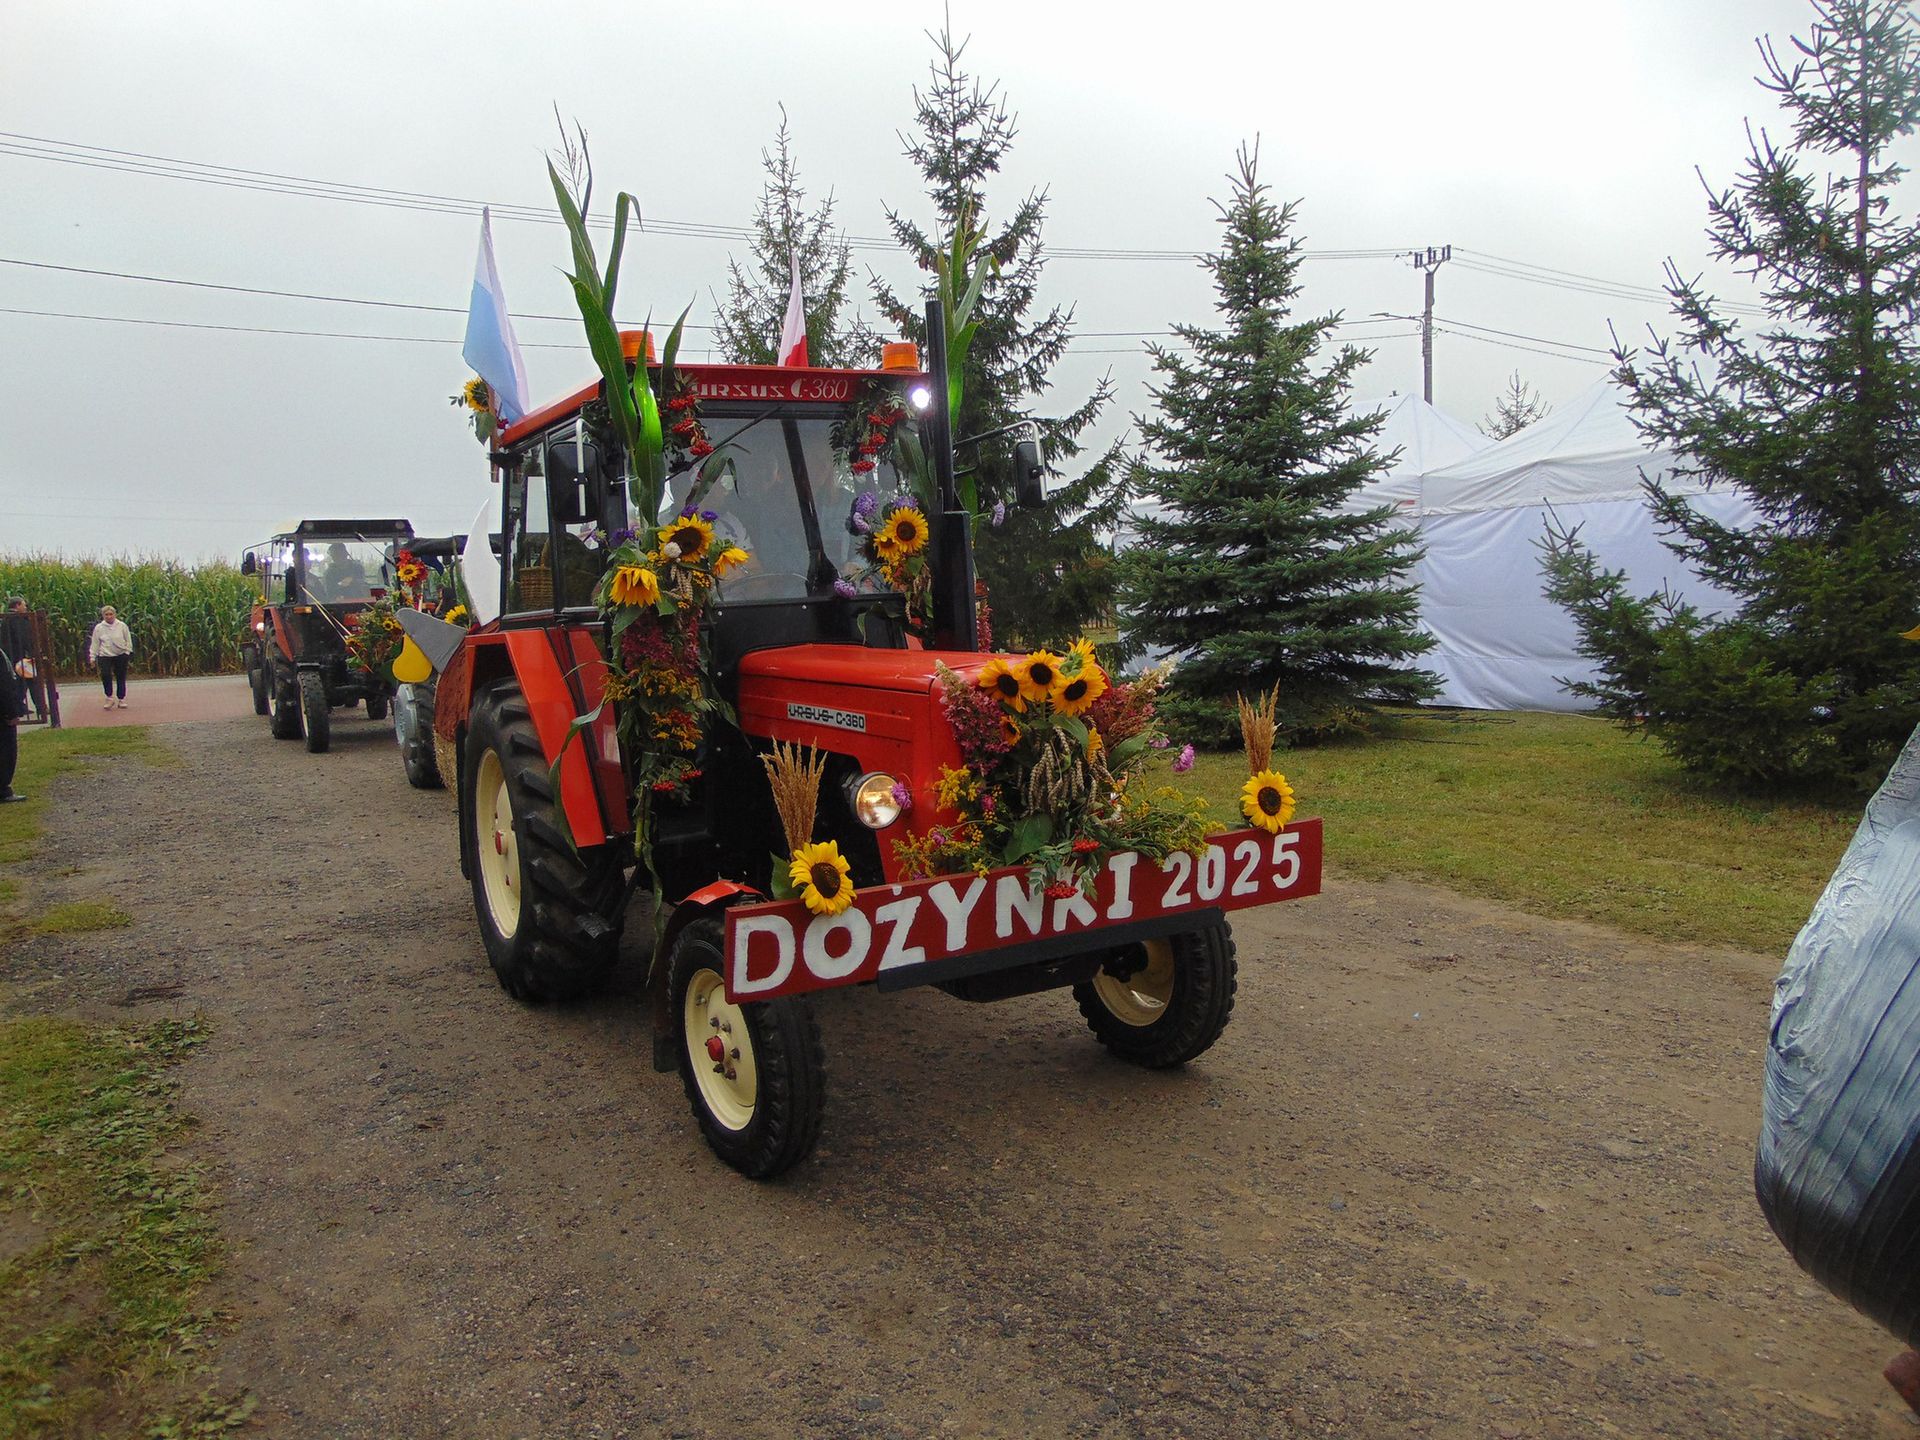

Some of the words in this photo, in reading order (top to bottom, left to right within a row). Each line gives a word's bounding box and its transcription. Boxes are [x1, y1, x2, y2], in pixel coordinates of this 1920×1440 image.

[790, 377, 849, 399] C-360
[836, 712, 864, 729] C-360
[732, 850, 1139, 994] DOŻYNKI
[1161, 832, 1301, 909] 2025
